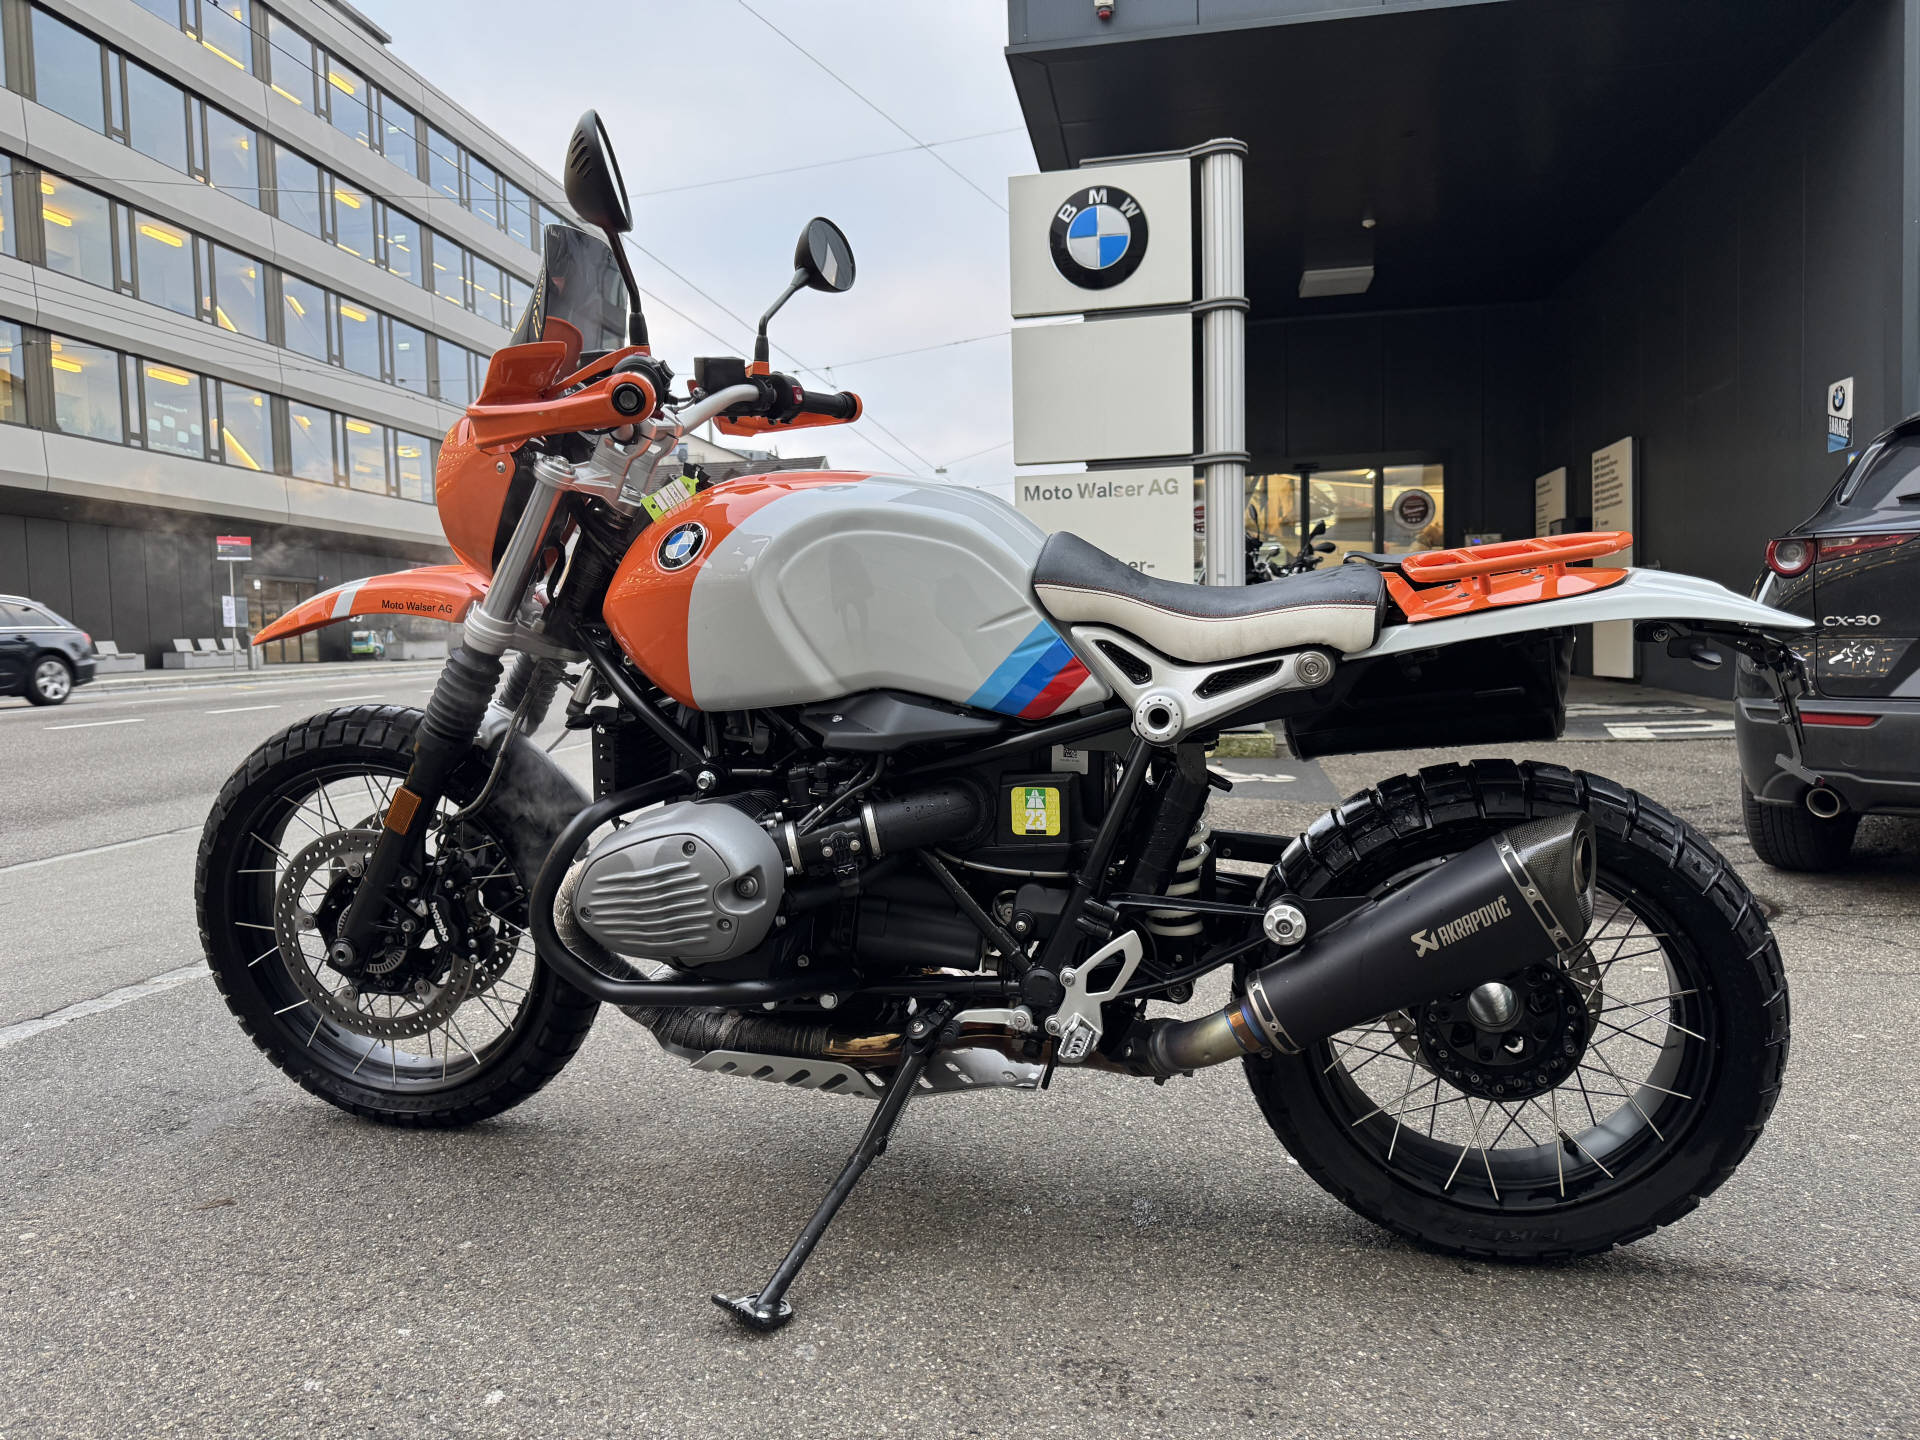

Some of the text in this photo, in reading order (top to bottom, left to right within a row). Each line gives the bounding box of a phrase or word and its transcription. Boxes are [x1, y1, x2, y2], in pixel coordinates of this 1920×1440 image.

[1058, 188, 1140, 223] BMW
[1024, 478, 1179, 501] Moto Walser AG
[381, 600, 453, 614] Moto Walser AG
[1822, 614, 1881, 627] CX-30
[1025, 809, 1047, 830] 23
[429, 902, 450, 942] brembo
